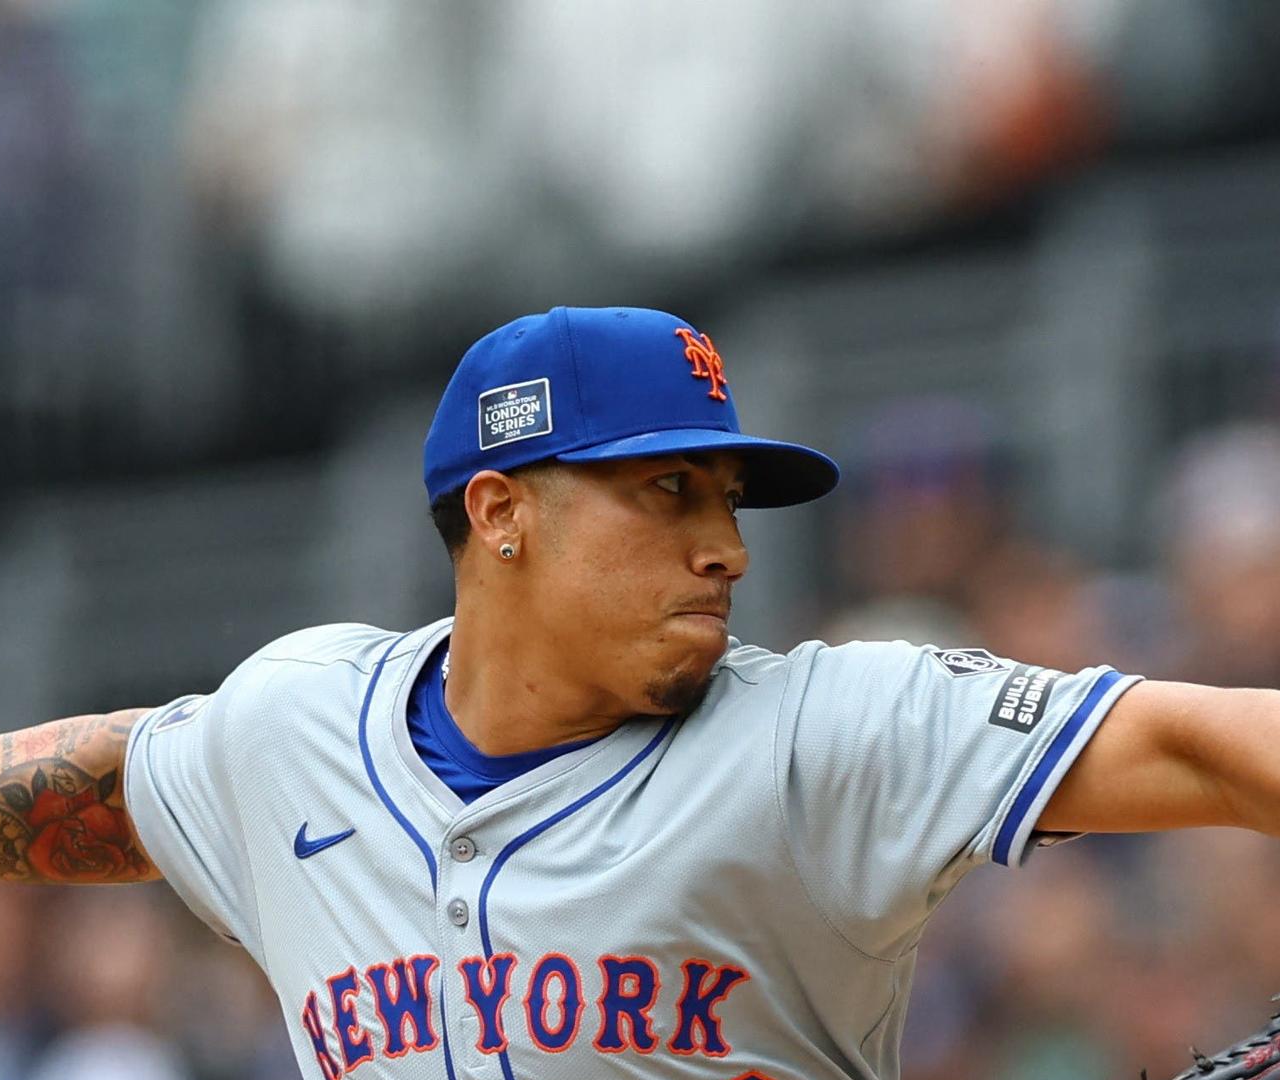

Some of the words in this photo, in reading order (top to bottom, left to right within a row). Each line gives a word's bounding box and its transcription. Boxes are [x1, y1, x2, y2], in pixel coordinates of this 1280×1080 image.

[485, 401, 540, 425] LONDON
[498, 399, 520, 409] WORLD
[520, 395, 537, 404] TOUR
[490, 414, 535, 435] SERIES
[998, 676, 1029, 720] BUILD
[457, 951, 750, 1057] YORK
